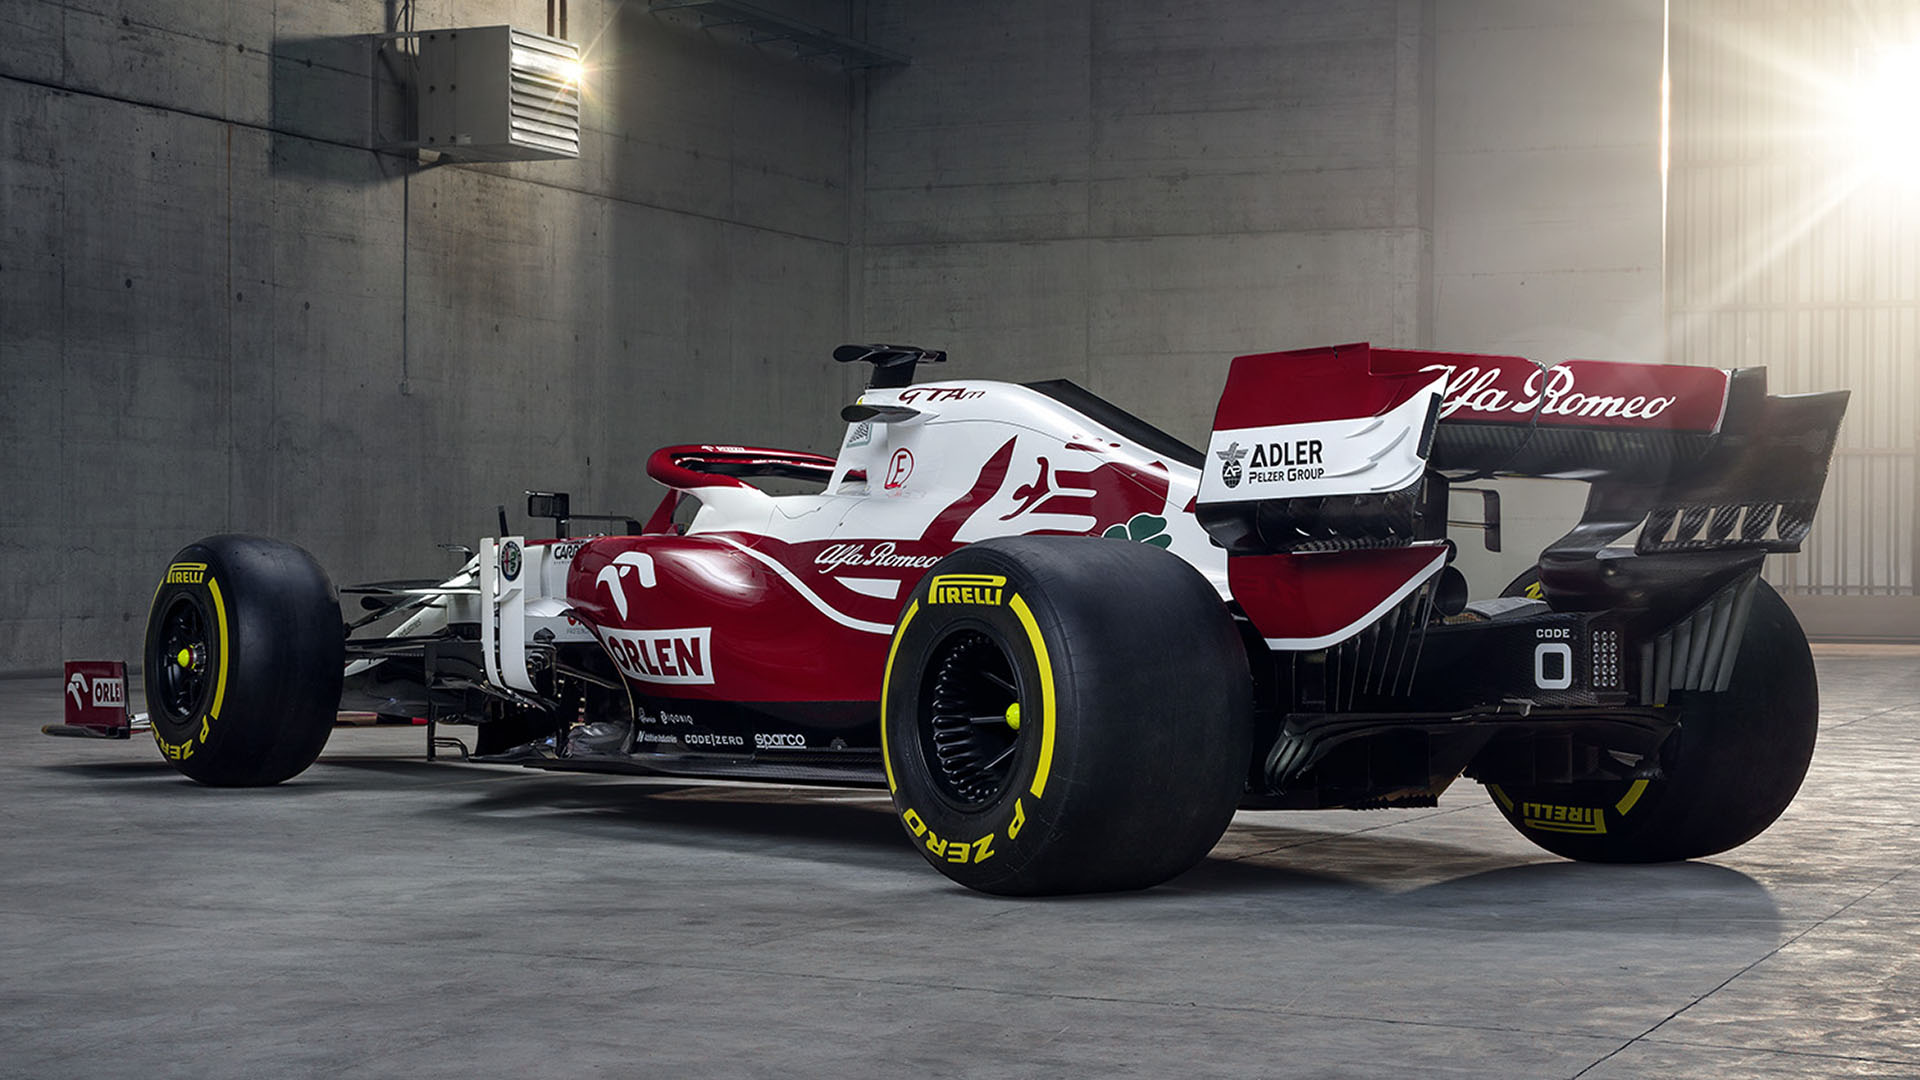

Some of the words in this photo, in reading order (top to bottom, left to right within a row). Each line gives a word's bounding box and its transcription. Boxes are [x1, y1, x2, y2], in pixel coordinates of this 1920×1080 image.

[1511, 366, 1676, 419] Romeo
[1249, 440, 1323, 468] ADLER
[1248, 471, 1285, 484] PELZER
[1287, 467, 1325, 482] GROUP
[166, 562, 208, 584] PIRELLI
[814, 543, 865, 574] Alfa
[862, 541, 944, 569] Romeo
[928, 573, 1008, 606] PIRELLI
[1535, 628, 1571, 639] CODE
[608, 635, 705, 677] ORLEN
[95, 682, 123, 703] ORLE
[199, 714, 210, 744] P
[754, 733, 807, 750] sparco
[1007, 797, 1026, 840] P
[1523, 802, 1607, 834] PIRELLI
[903, 808, 995, 864] ZERO
